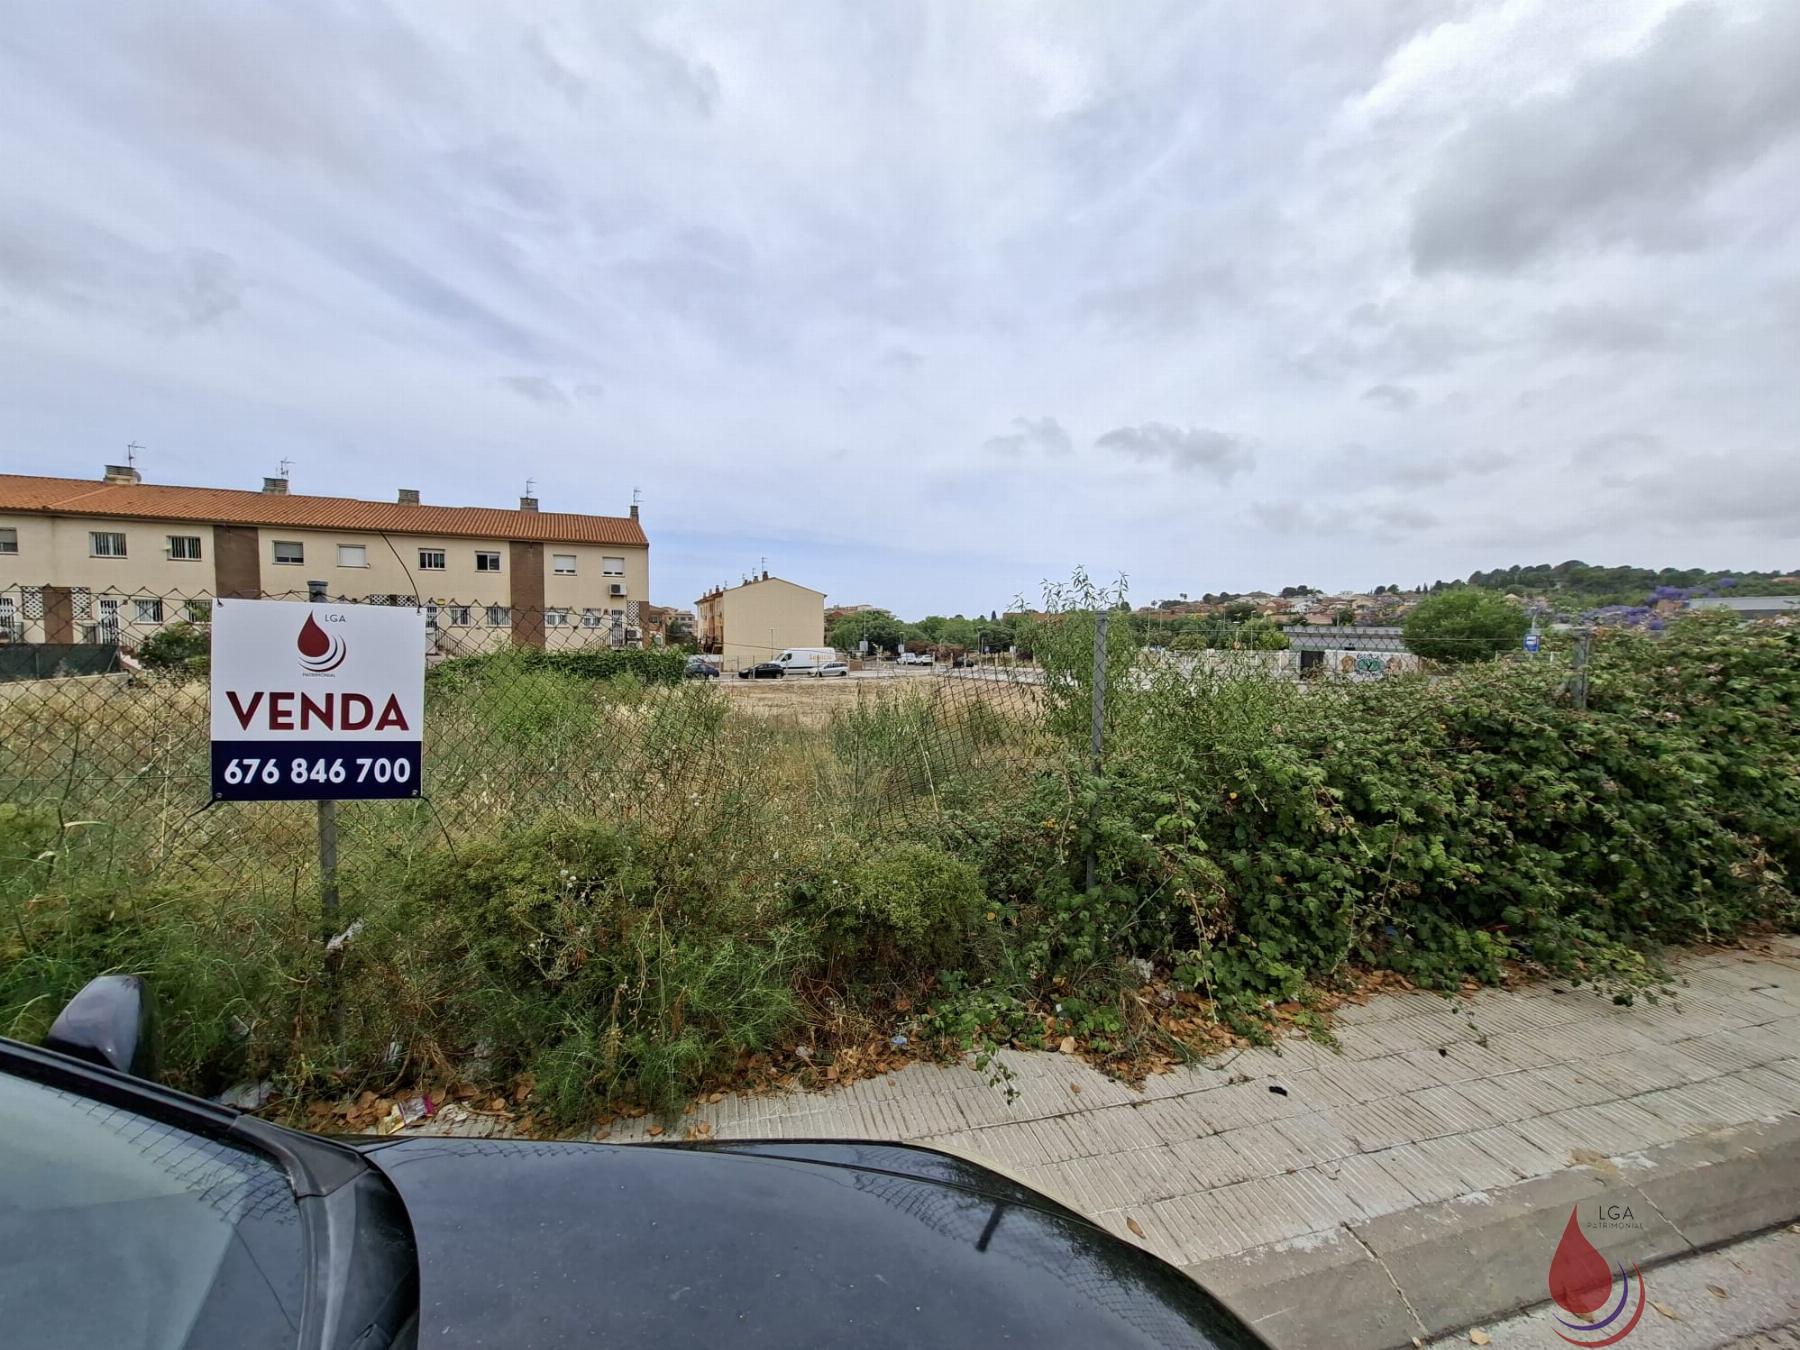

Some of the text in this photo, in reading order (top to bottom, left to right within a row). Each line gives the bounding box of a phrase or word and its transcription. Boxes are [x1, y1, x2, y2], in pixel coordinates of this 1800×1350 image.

[324, 614, 347, 623] LGA
[225, 690, 410, 732] VENDA
[224, 757, 411, 784] 676 846 700
